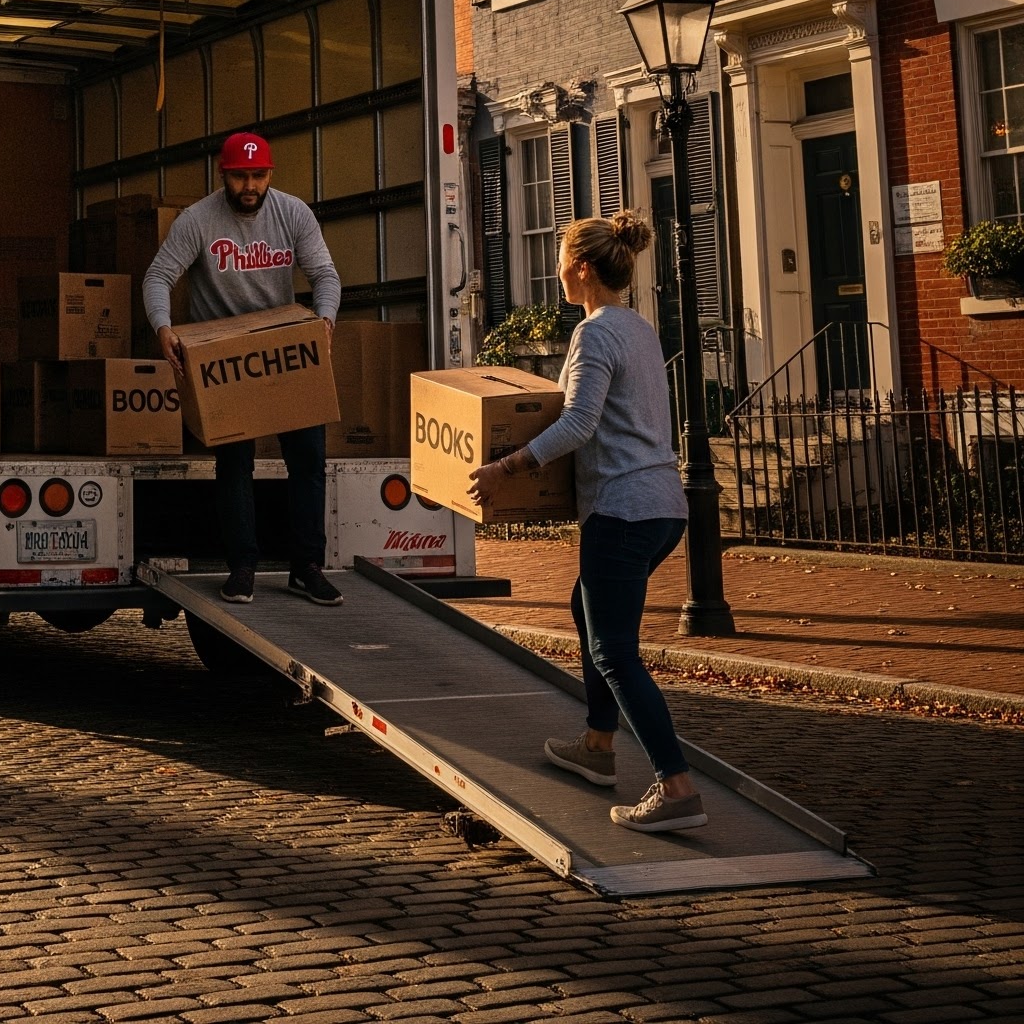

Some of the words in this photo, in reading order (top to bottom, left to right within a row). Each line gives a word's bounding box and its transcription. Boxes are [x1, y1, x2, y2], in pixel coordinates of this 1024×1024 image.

[243, 142, 258, 160] P
[199, 340, 320, 389] KITCHEN
[415, 411, 475, 464] BOOKS
